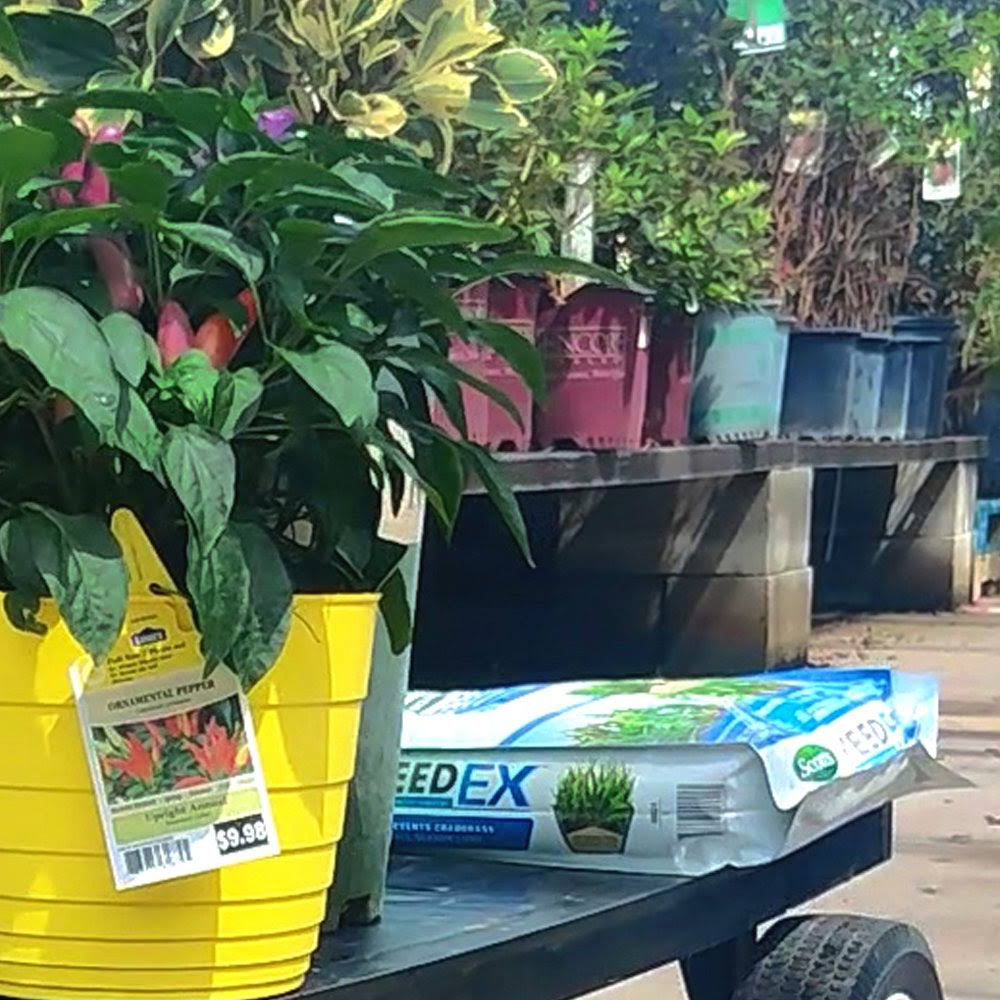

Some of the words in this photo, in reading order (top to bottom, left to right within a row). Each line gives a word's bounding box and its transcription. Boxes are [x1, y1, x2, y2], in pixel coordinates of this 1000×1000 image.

[108, 687, 174, 711] ORNAMENTAL
[176, 680, 215, 697] PEPPER
[397, 762, 537, 807] EEDEX
[217, 820, 267, 850] $9.98
[392, 821, 432, 832] EVENTS
[434, 823, 495, 834] CRABGRASS
